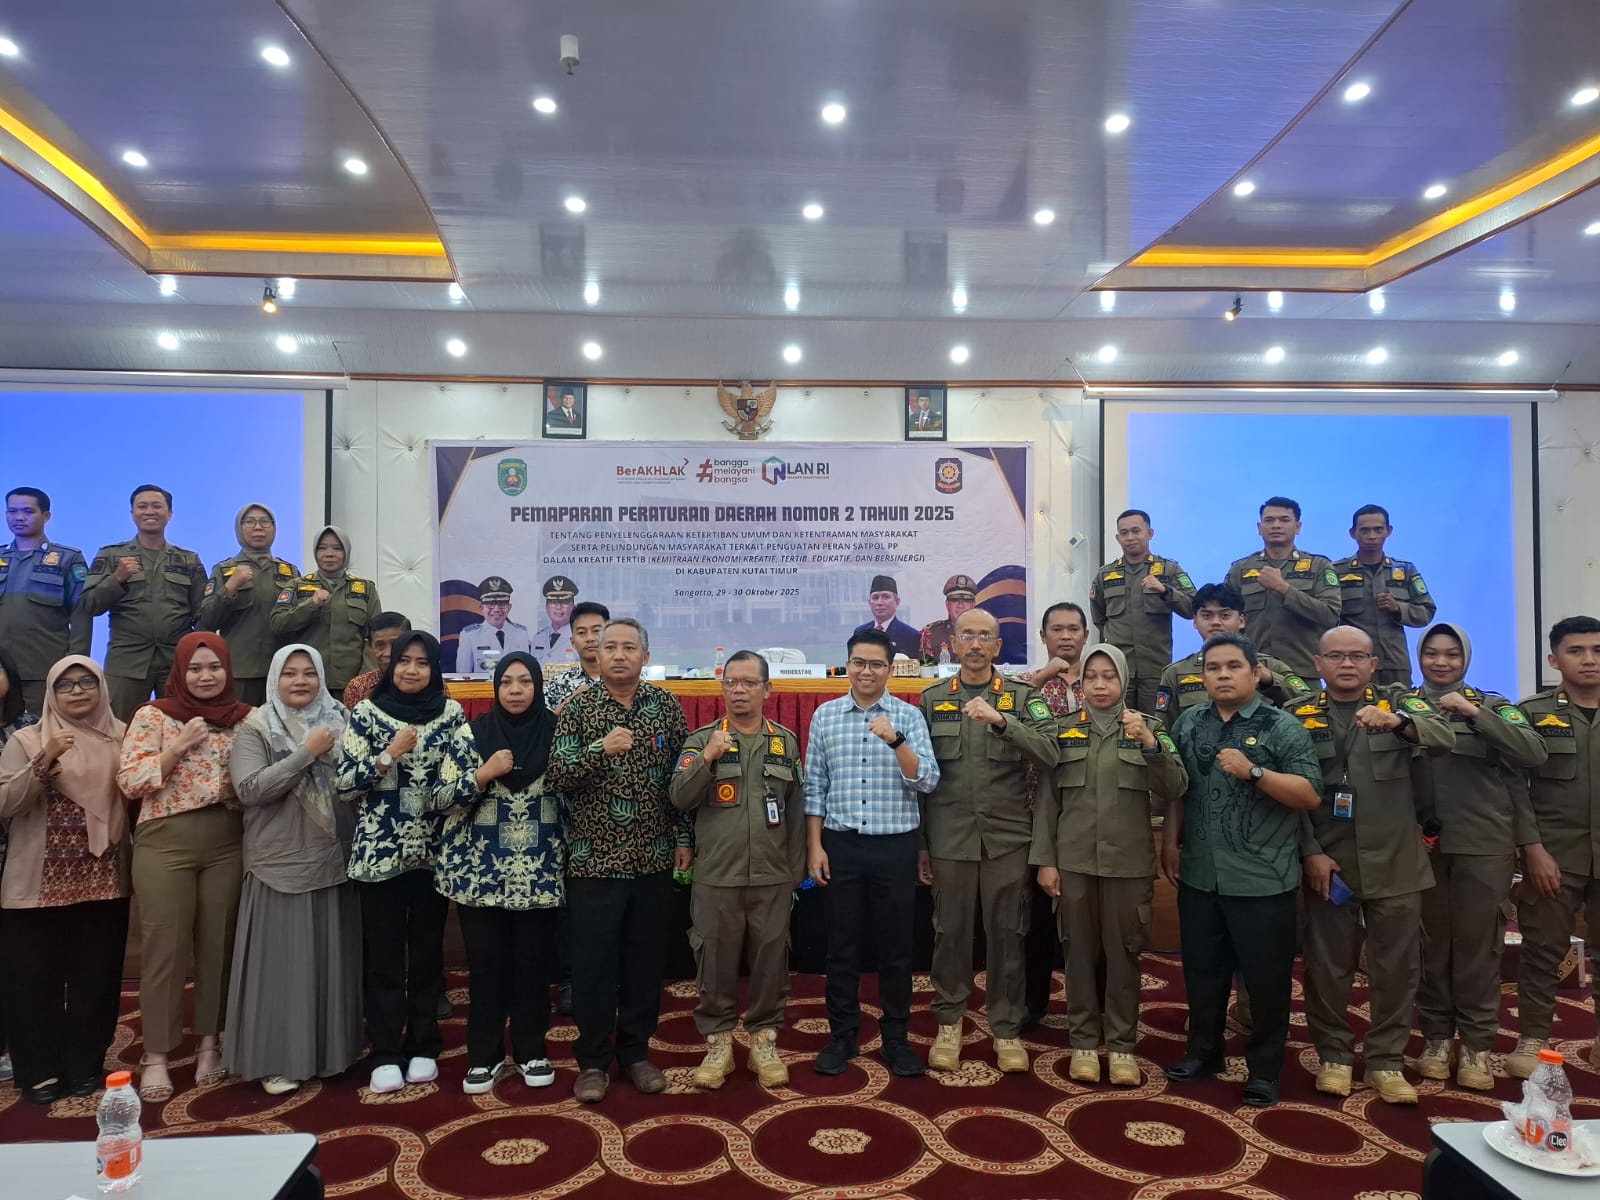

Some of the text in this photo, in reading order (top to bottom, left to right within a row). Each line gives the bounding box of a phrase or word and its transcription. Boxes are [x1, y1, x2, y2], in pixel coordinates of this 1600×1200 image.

[714, 459, 749, 468] bangga
[616, 466, 685, 476] BerAKHLAK
[714, 468, 755, 477] melayani
[787, 462, 830, 475] LAN RI
[714, 476, 748, 485] bangsa
[510, 505, 954, 522] PEMAPARAN PERATURAN DAERAH NOMOR 2 TAHUN 2025
[550, 531, 592, 539] TENTANG
[594, 531, 683, 539] PENYELENGGARAAN
[686, 531, 739, 539] KETERTIBAN
[741, 531, 770, 539] UMUM
[860, 530, 918, 538] MASYARAKAT
[571, 543, 598, 551] SERTA
[600, 543, 666, 551] PELINDUNGAN
[668, 543, 726, 551] MASYARAKAT
[730, 543, 765, 551] TERKAIT
[767, 543, 820, 551] PENGUATAN
[543, 556, 576, 564] DALAM
[701, 555, 742, 563] EKONOMI
[855, 554, 874, 562] DAN
[875, 554, 925, 563] BERSINERGI)
[675, 567, 685, 575] DI
[687, 567, 740, 575] KABUPATEN
[742, 567, 768, 575] KUTAI
[716, 588, 726, 596] 29
[734, 588, 743, 596] 30
[745, 588, 778, 596] Oktober
[780, 588, 800, 596] 2025
